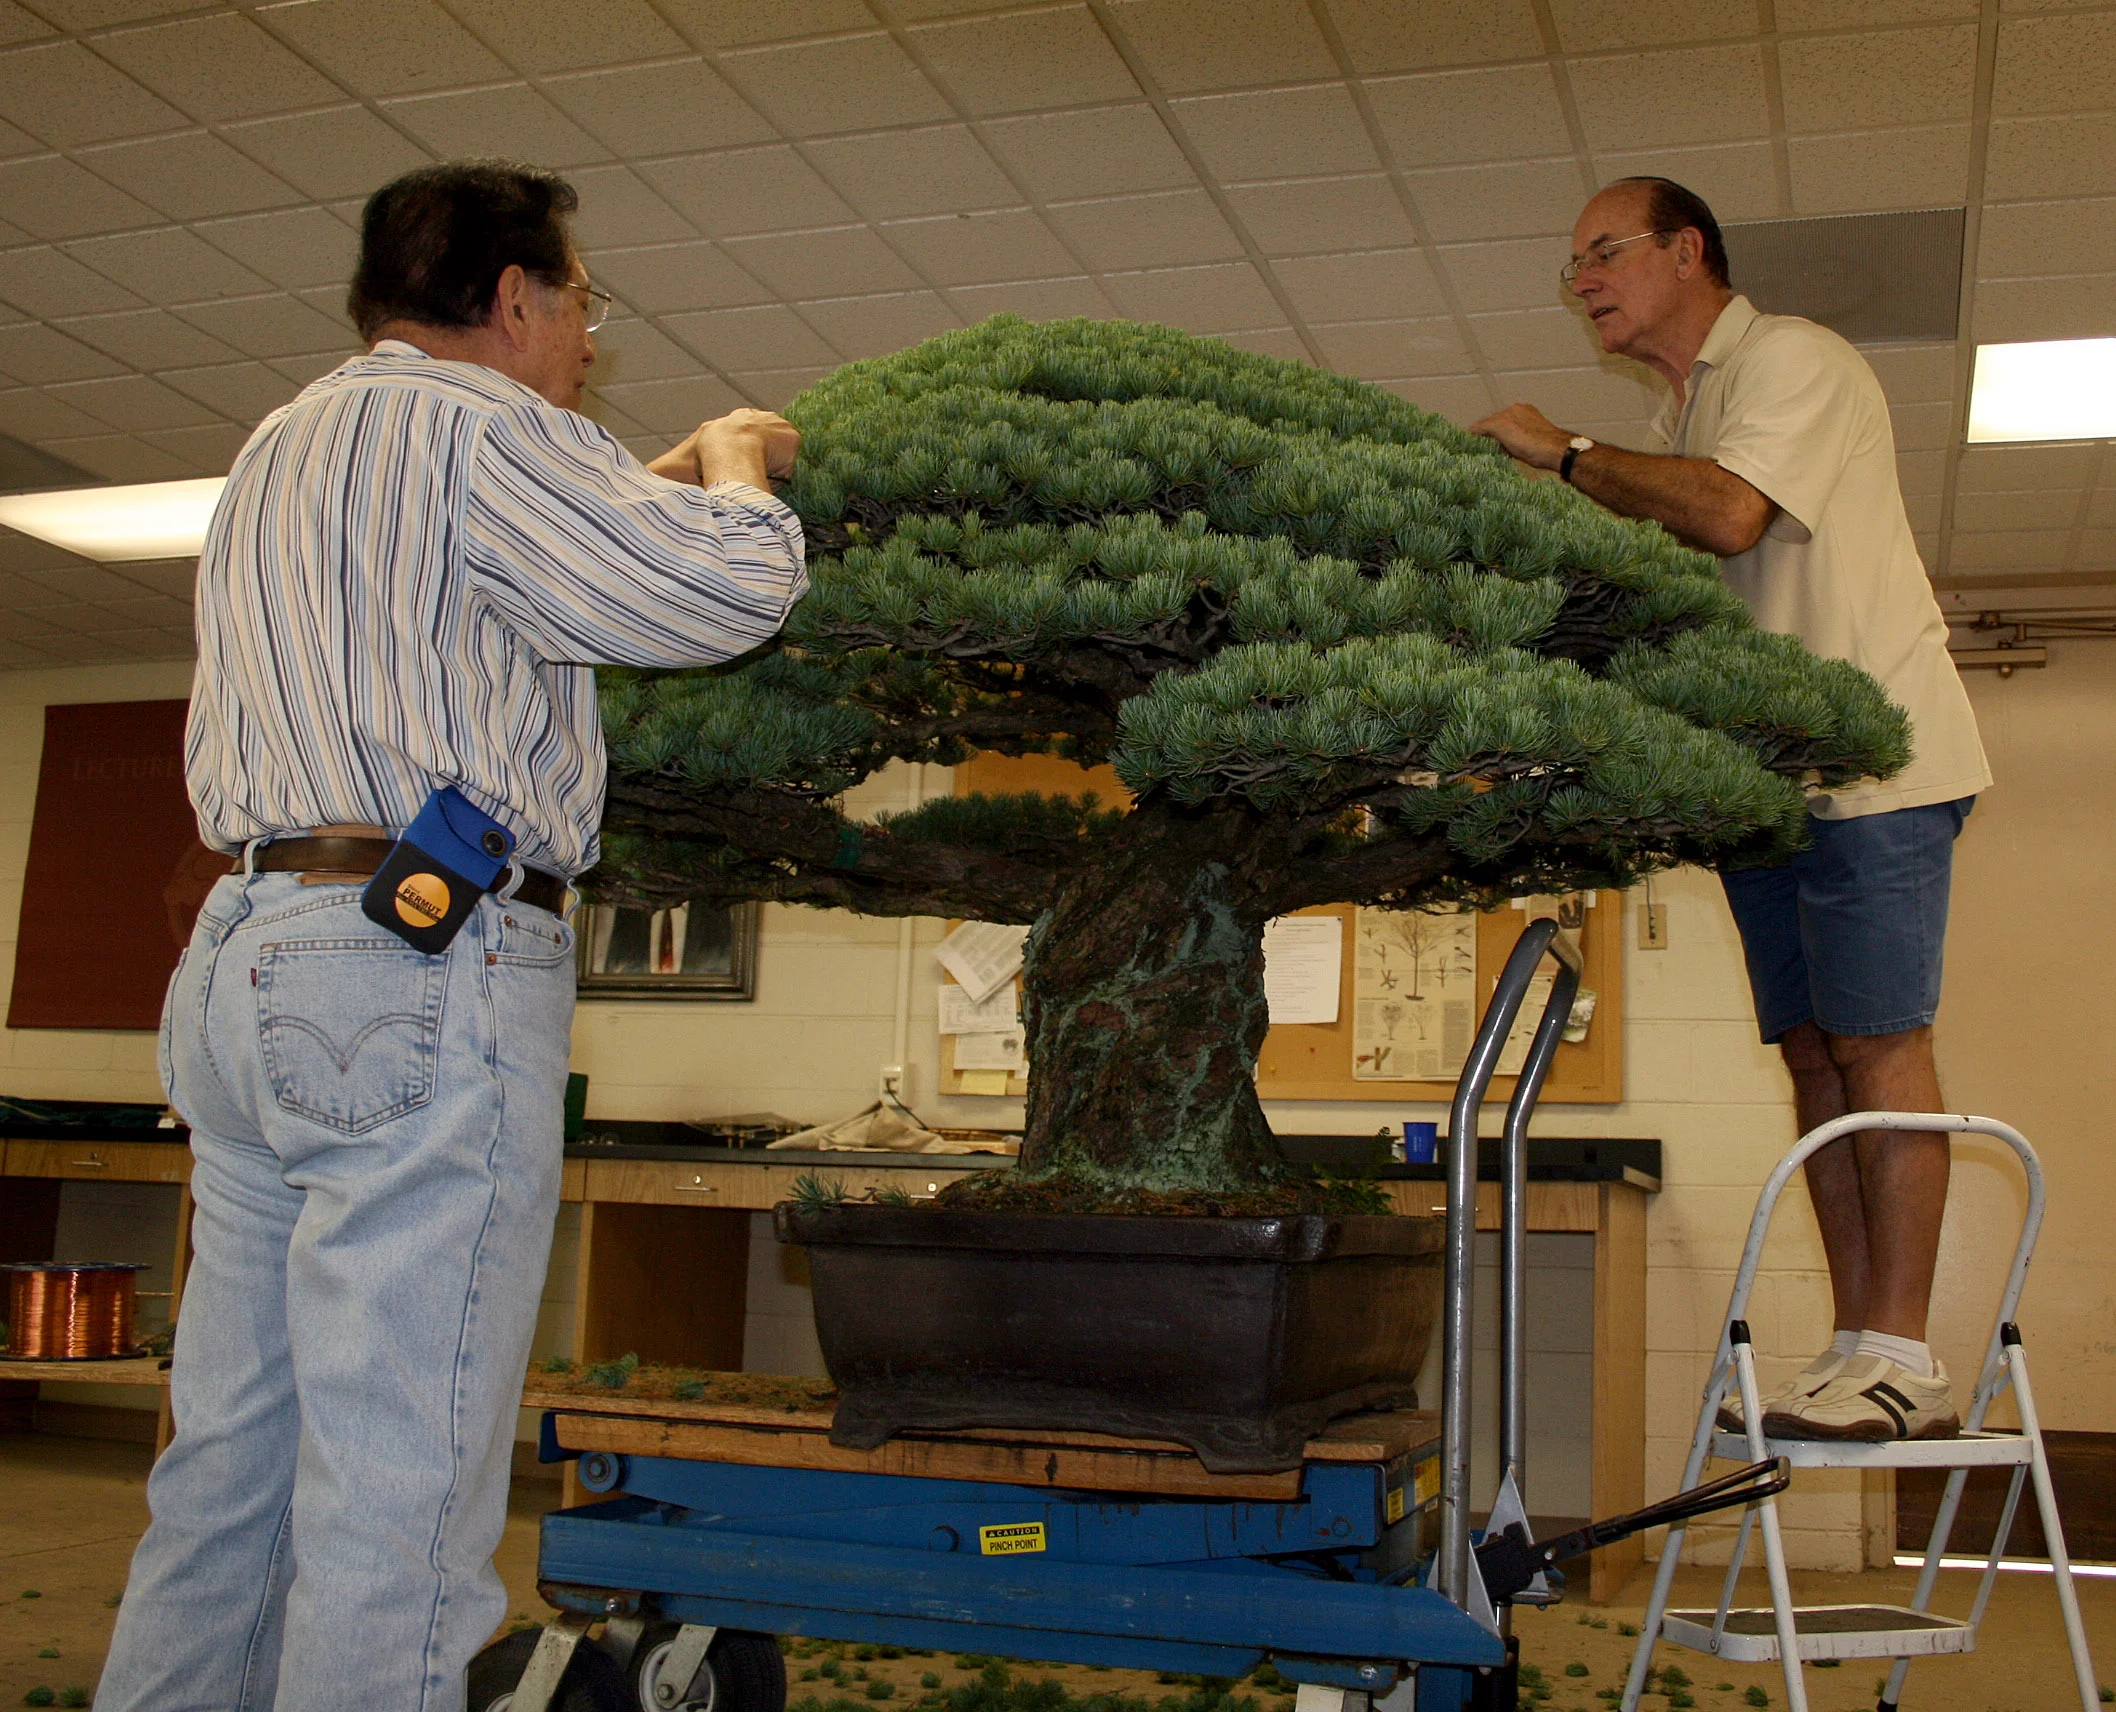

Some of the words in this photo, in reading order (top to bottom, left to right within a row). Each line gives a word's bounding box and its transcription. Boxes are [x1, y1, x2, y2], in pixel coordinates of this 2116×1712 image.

[403, 887, 442, 915] PERMUT
[997, 1528, 1037, 1536] CAUTION
[989, 1540, 1013, 1551] PINCH
[1014, 1538, 1037, 1550] POINT
